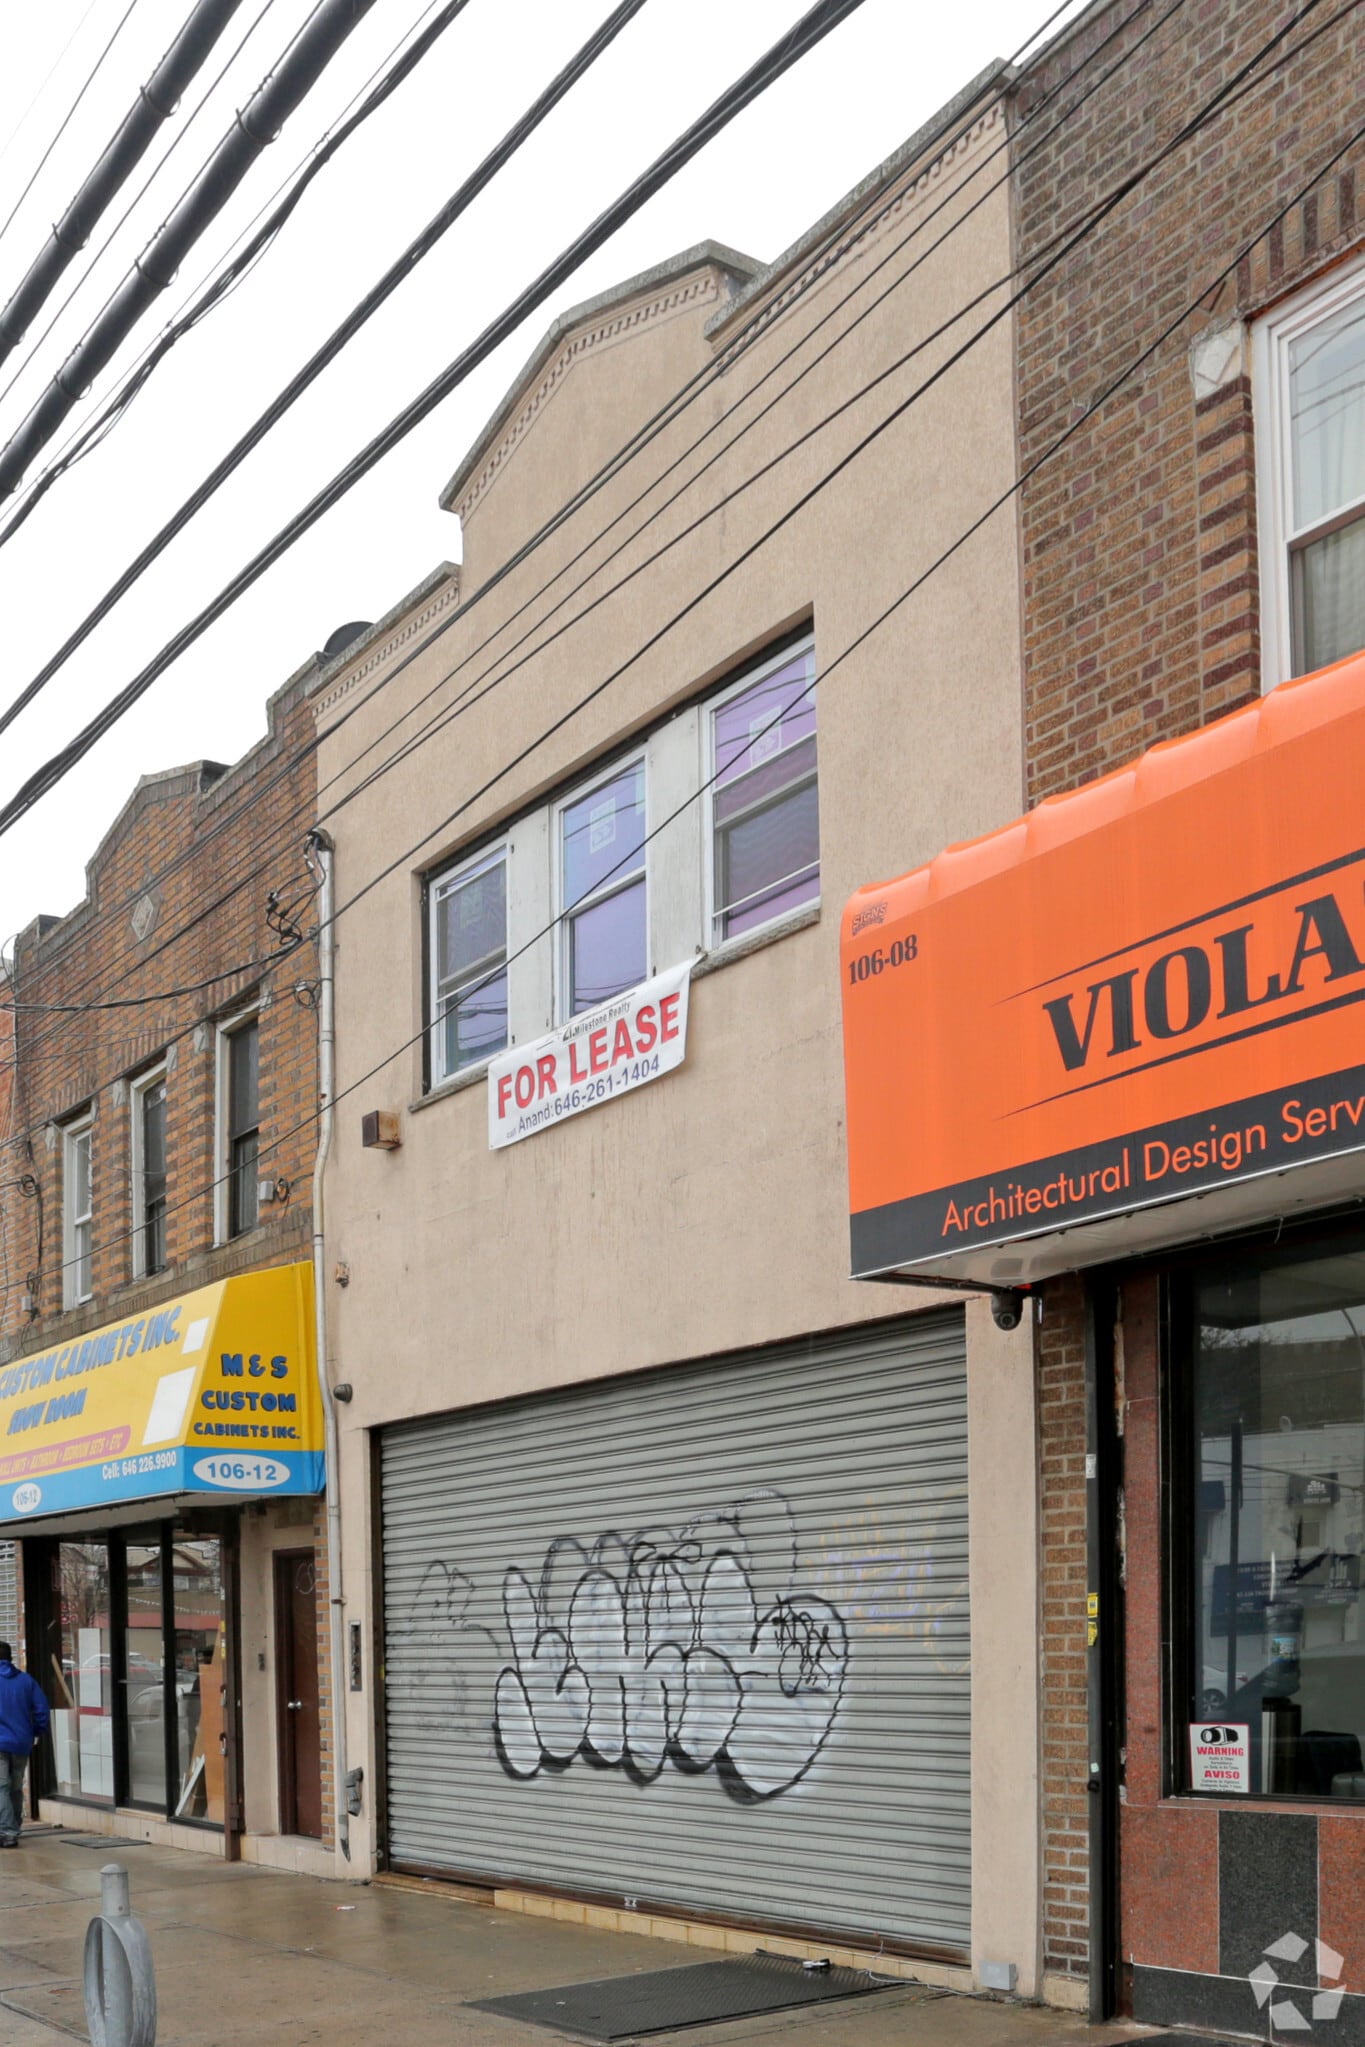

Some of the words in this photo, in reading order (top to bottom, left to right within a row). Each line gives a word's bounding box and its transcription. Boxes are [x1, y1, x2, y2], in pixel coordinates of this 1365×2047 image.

[848, 934, 918, 985] 106-08
[1042, 880, 1365, 1071] VIOLA
[608, 1001, 631, 1020] Realty
[498, 1053, 557, 1119] FOR
[568, 992, 680, 1085] LEASE
[942, 1148, 1130, 1235] Architectural
[1145, 1124, 1266, 1181] Design
[1281, 1096, 1365, 1143] Serv
[55, 1318, 144, 1381] CABINETS
[221, 1353, 243, 1377] M
[249, 1354, 266, 1377] &
[271, 1355, 288, 1379] S
[201, 1390, 297, 1412] CUSTOM
[194, 1422, 269, 1438] CABINETS
[271, 1426, 301, 1439] INC.
[102, 1462, 120, 1480] Cell:
[122, 1459, 137, 1476] 646
[208, 1462, 277, 1480] 106-12
[1197, 1746, 1244, 1756] WARNING
[1204, 1770, 1240, 1780] AVISO
